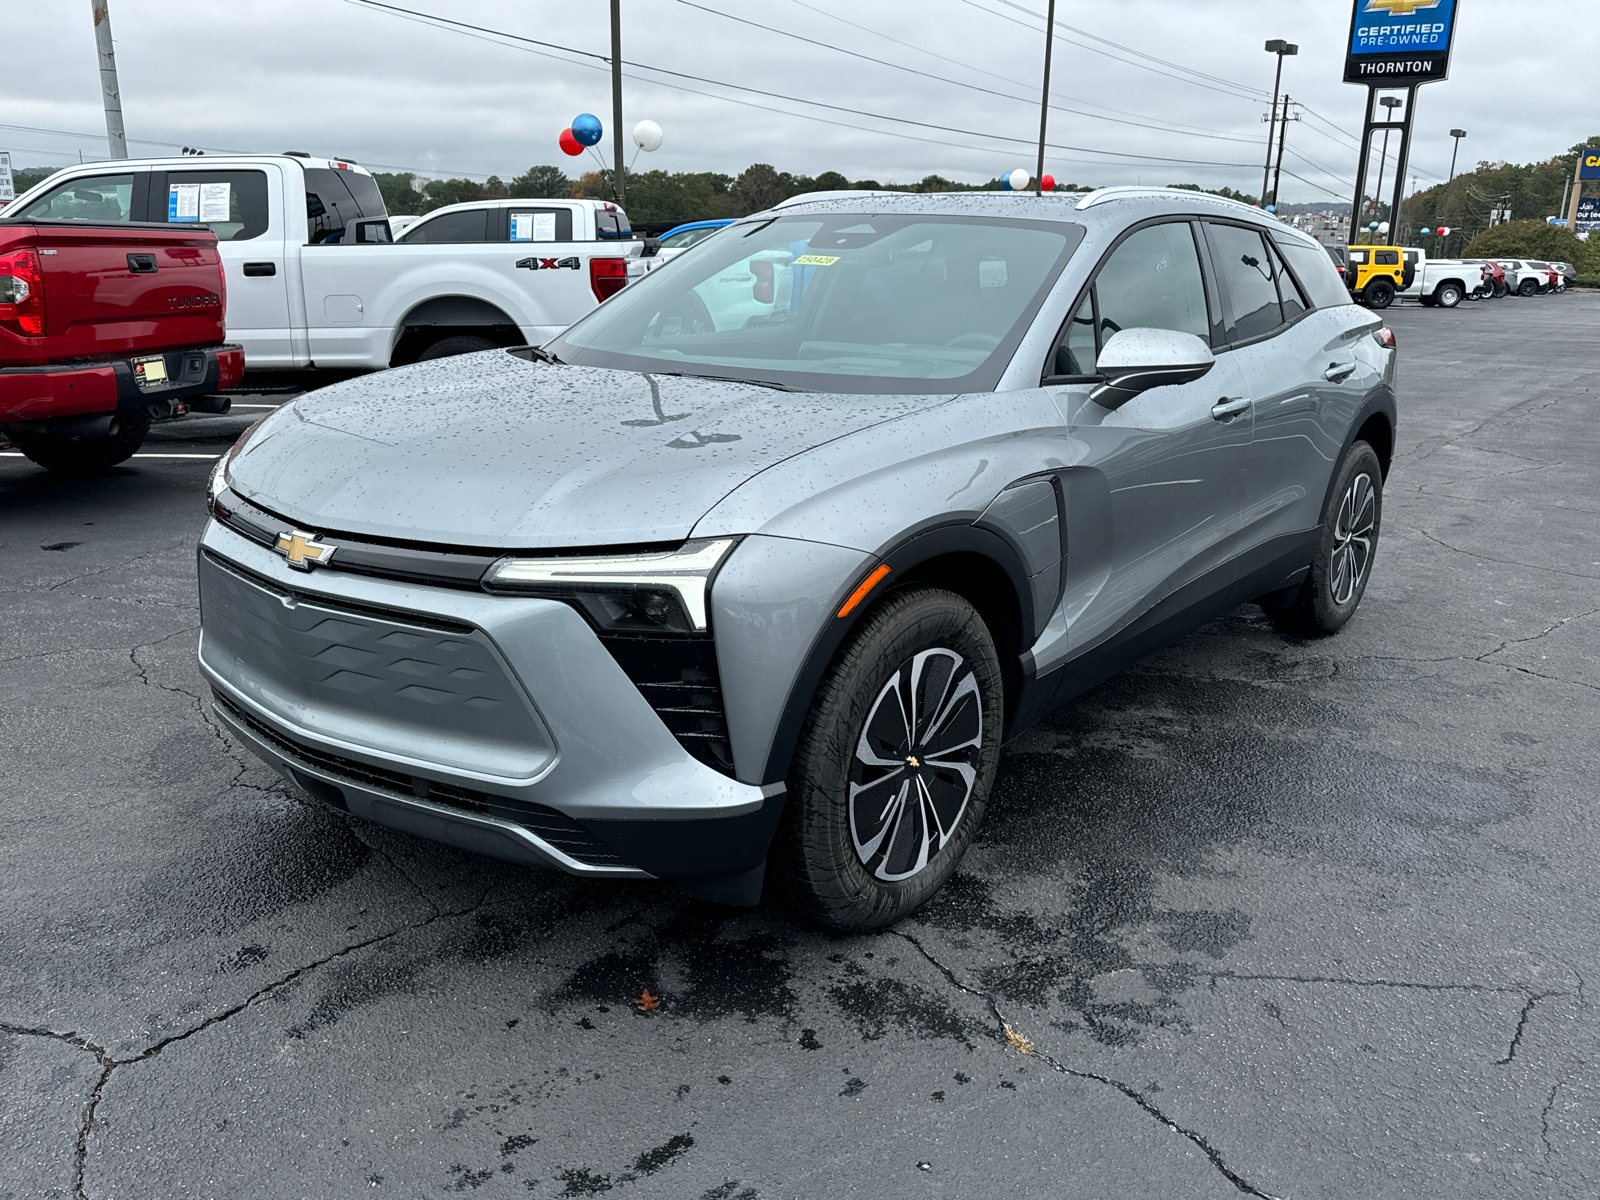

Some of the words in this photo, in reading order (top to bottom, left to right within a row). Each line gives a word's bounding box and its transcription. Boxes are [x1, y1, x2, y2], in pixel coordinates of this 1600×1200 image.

[1358, 23, 1444, 37] CERTIFIED
[1360, 34, 1438, 46] PRE-OWNED
[1359, 61, 1432, 74] THORNTON
[797, 255, 835, 264] 250428
[167, 293, 219, 309] TUNDRA
